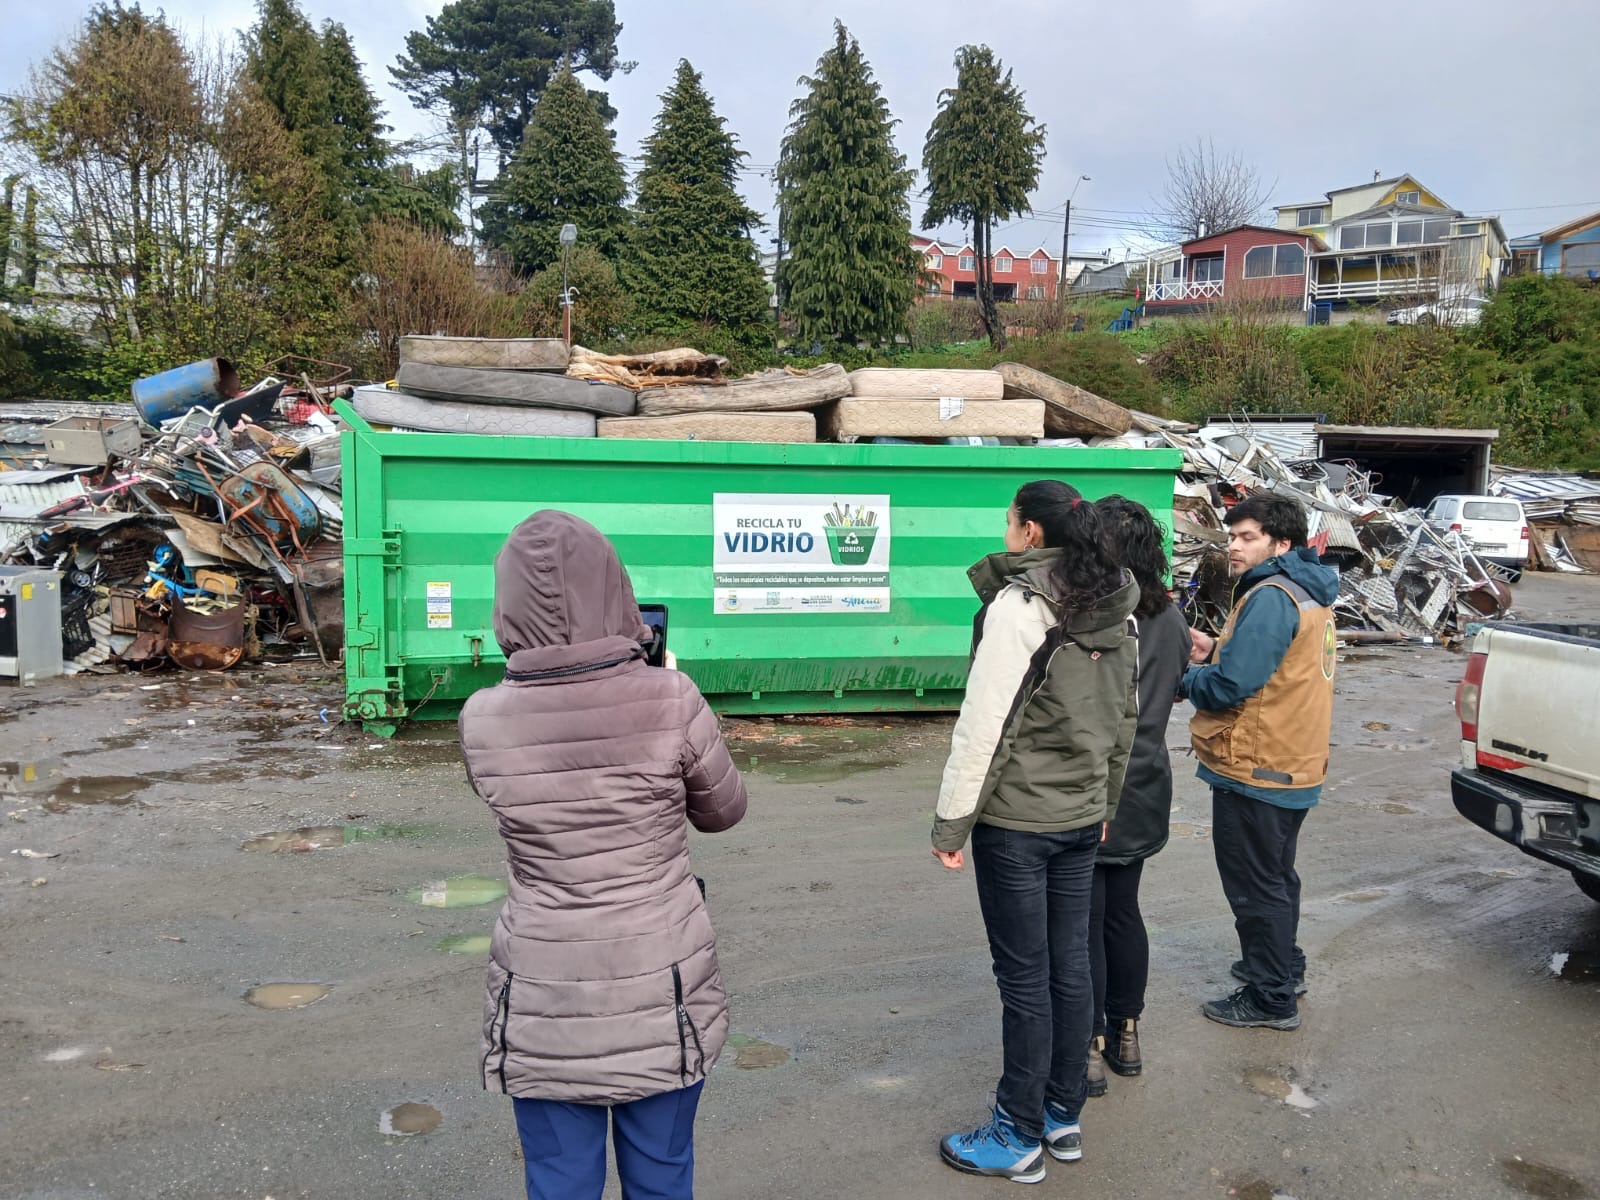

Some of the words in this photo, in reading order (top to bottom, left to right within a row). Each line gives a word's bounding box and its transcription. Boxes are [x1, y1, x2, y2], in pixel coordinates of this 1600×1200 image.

[736, 518, 784, 528] RECICLA
[787, 518, 802, 528] TU
[723, 532, 814, 553] VIDRIO
[740, 575, 764, 583] materiales
[765, 575, 788, 583] reciclables
